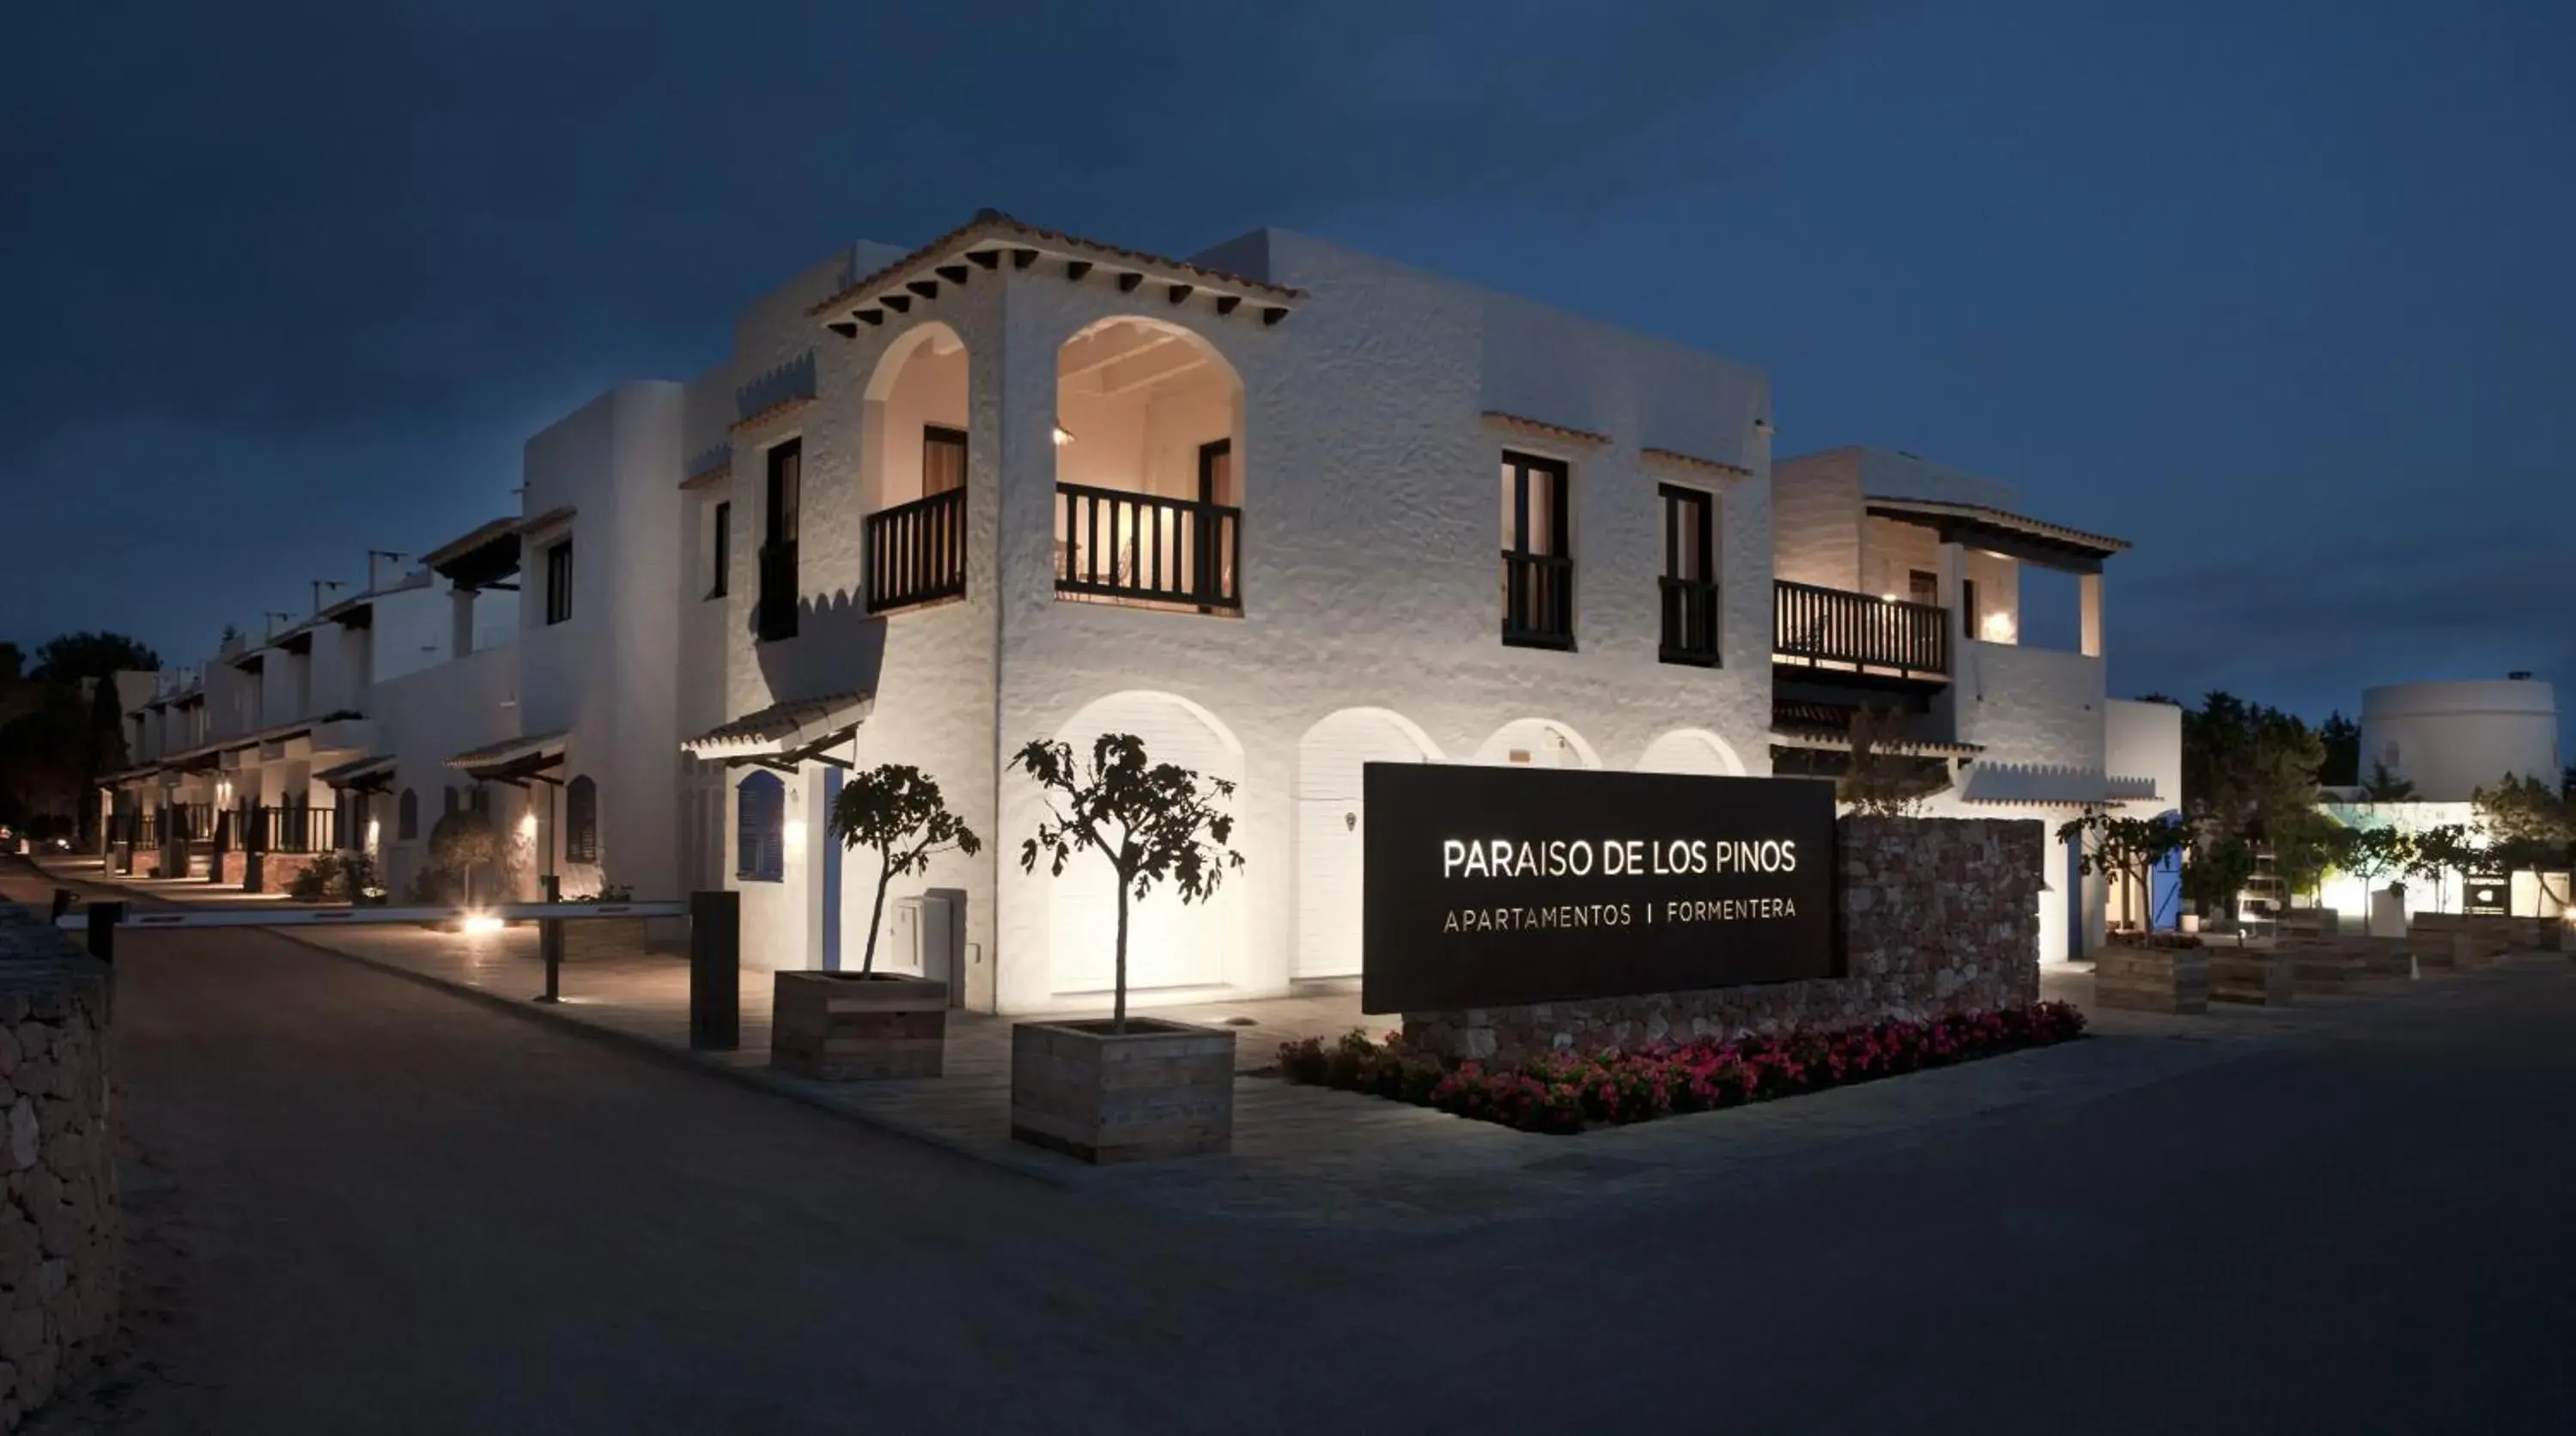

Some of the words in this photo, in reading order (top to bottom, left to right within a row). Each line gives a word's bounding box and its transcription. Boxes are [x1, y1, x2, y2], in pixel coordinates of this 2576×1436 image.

[1443, 838, 1594, 879] PARAISO
[1603, 839, 1644, 875] DE
[1653, 839, 1708, 875] LOS
[1716, 839, 1796, 873] PINOS
[1443, 904, 1631, 933] APARTAMENTOS
[1668, 898, 1796, 922] FORMENTERA
